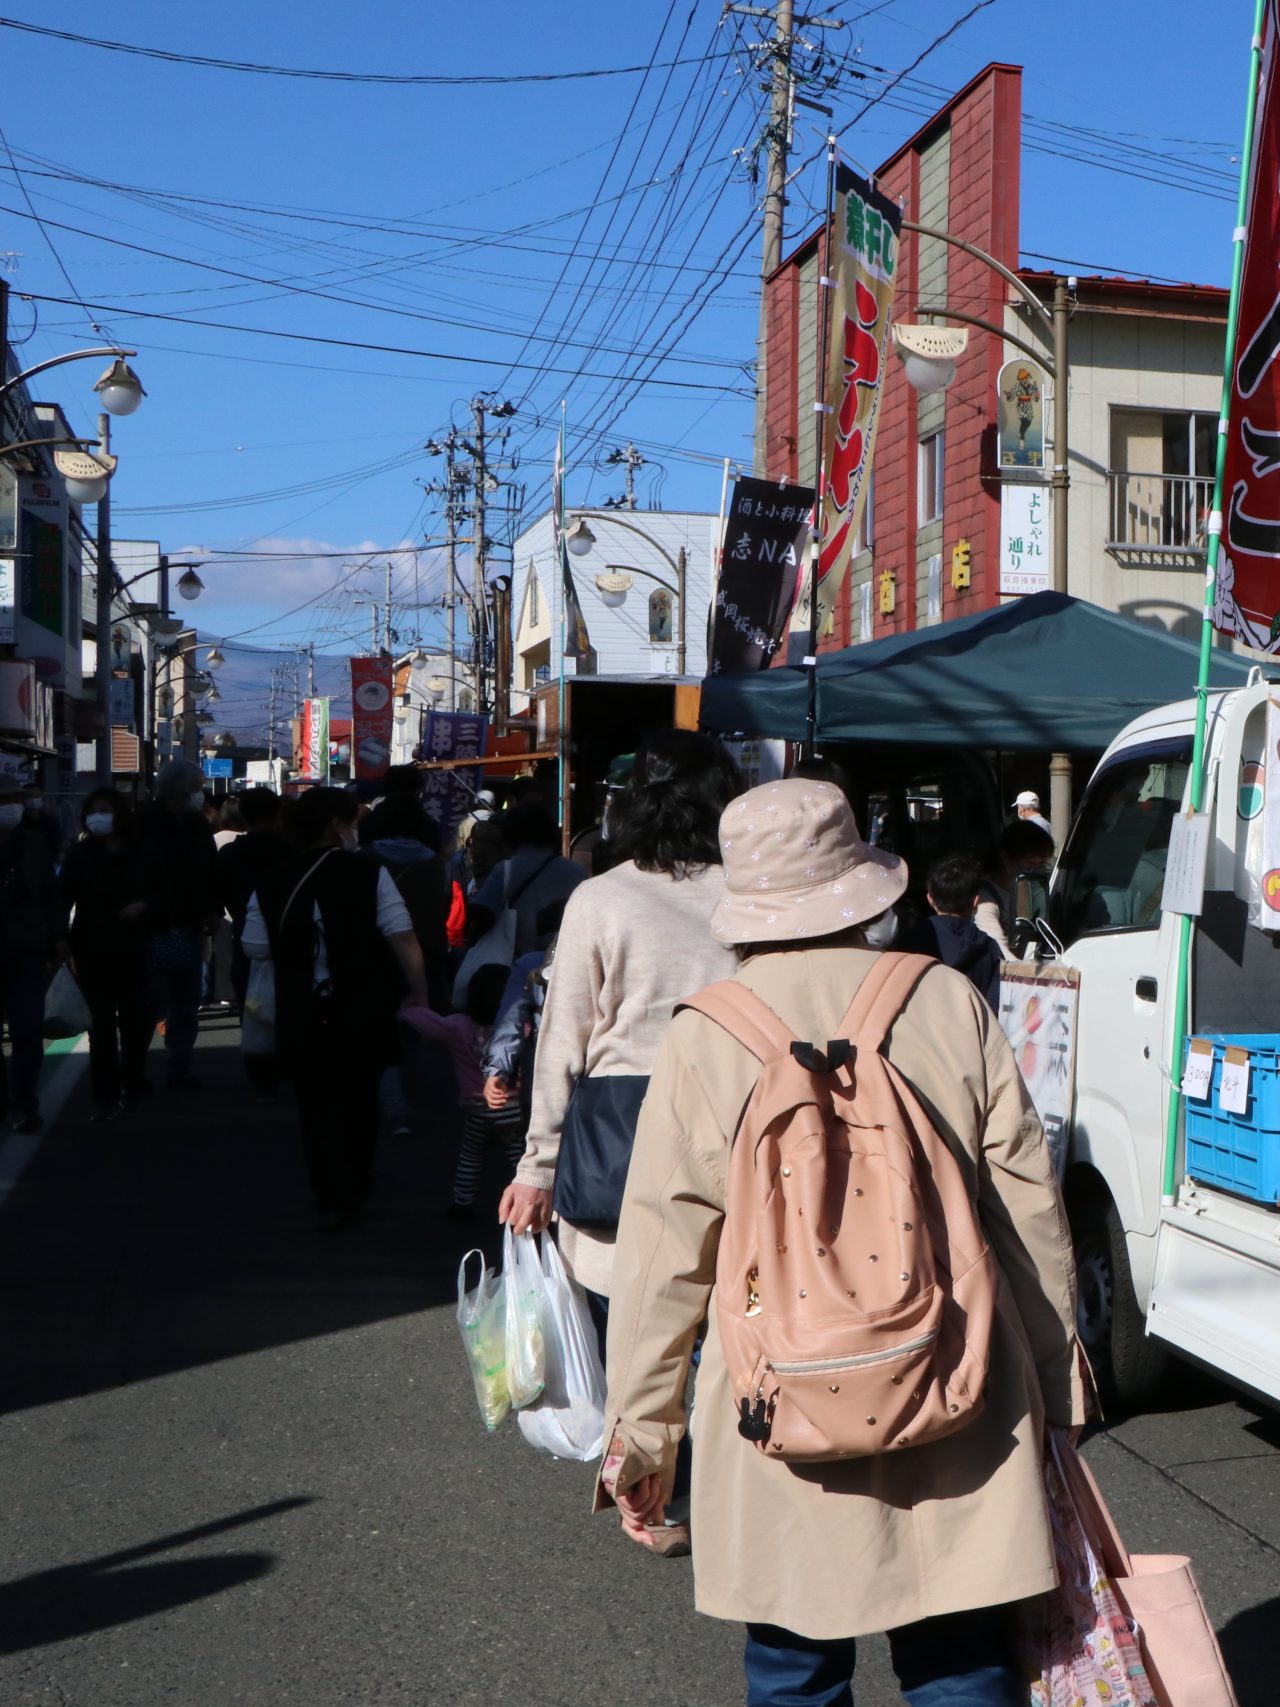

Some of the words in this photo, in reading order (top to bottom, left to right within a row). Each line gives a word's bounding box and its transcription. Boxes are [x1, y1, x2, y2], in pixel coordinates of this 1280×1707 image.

[845, 189, 896, 279] 煮干し
[737, 496, 813, 524] 酒と小料理
[1027, 492, 1042, 556] よしゃれ
[1008, 536, 1024, 571] 通り
